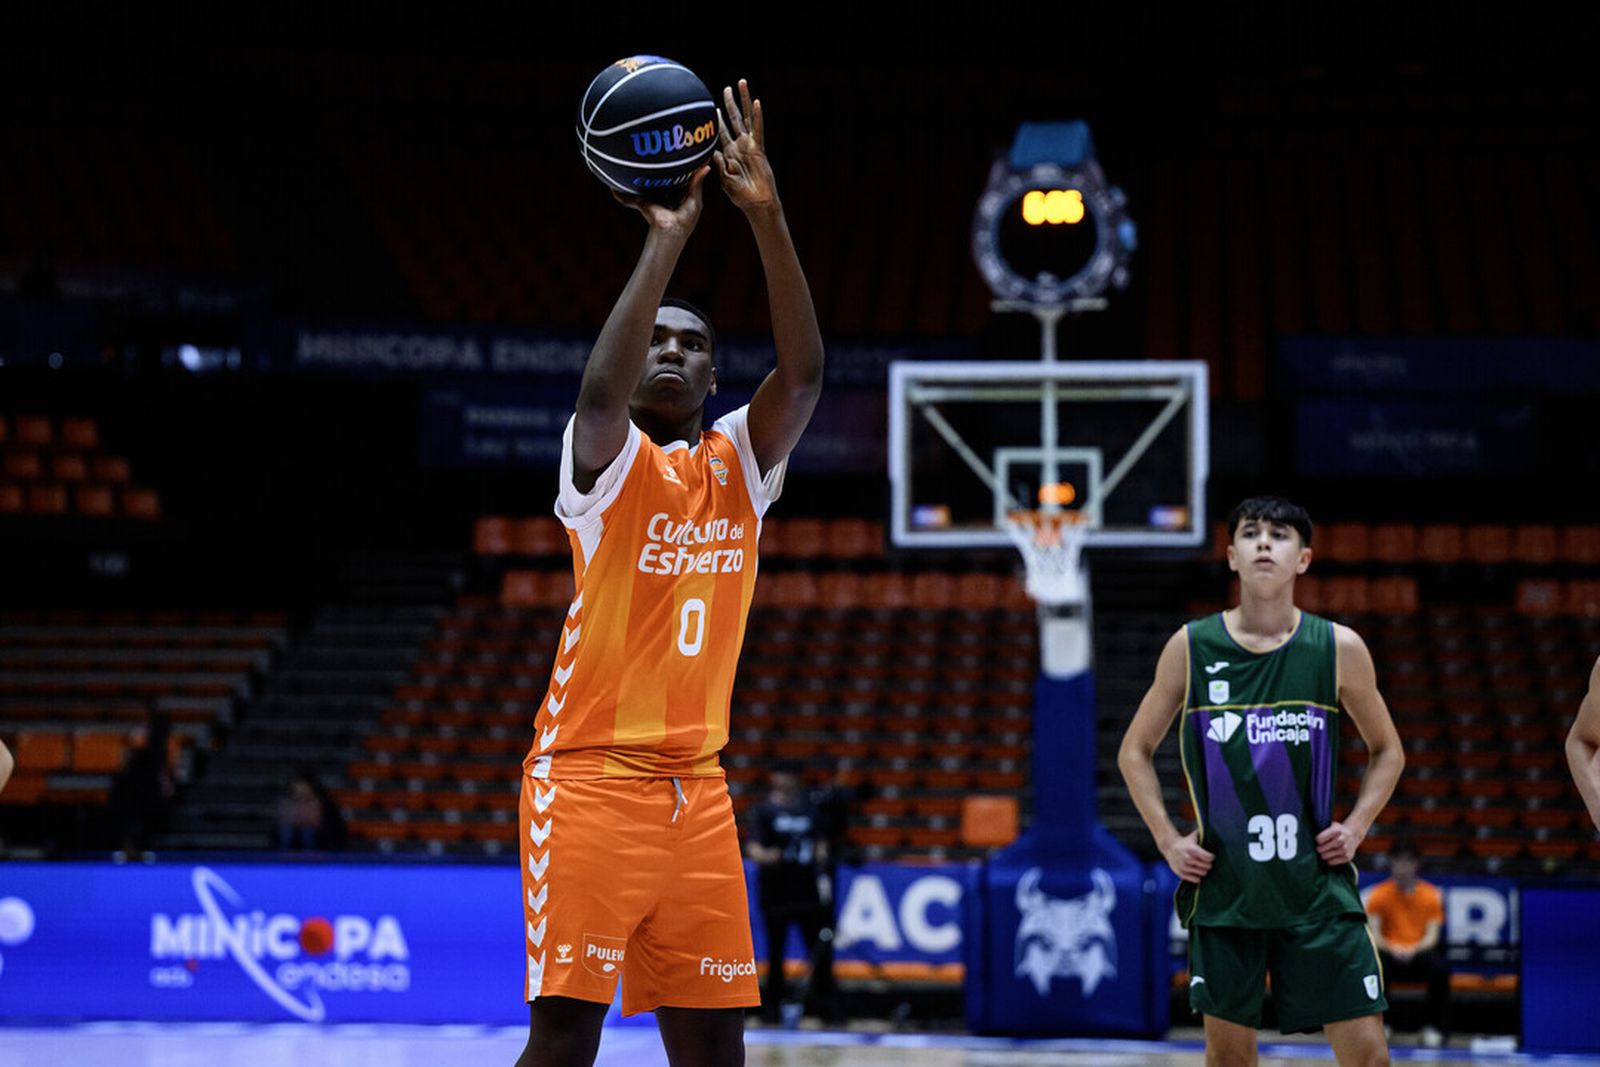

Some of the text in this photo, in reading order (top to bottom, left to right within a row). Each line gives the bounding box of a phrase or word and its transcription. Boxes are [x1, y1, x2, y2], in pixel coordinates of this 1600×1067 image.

[630, 120, 714, 156] Wilson
[647, 512, 744, 545] Cultura del
[678, 599, 705, 656] 0
[1247, 726, 1310, 746] Unicaja
[1248, 814, 1298, 861] 38
